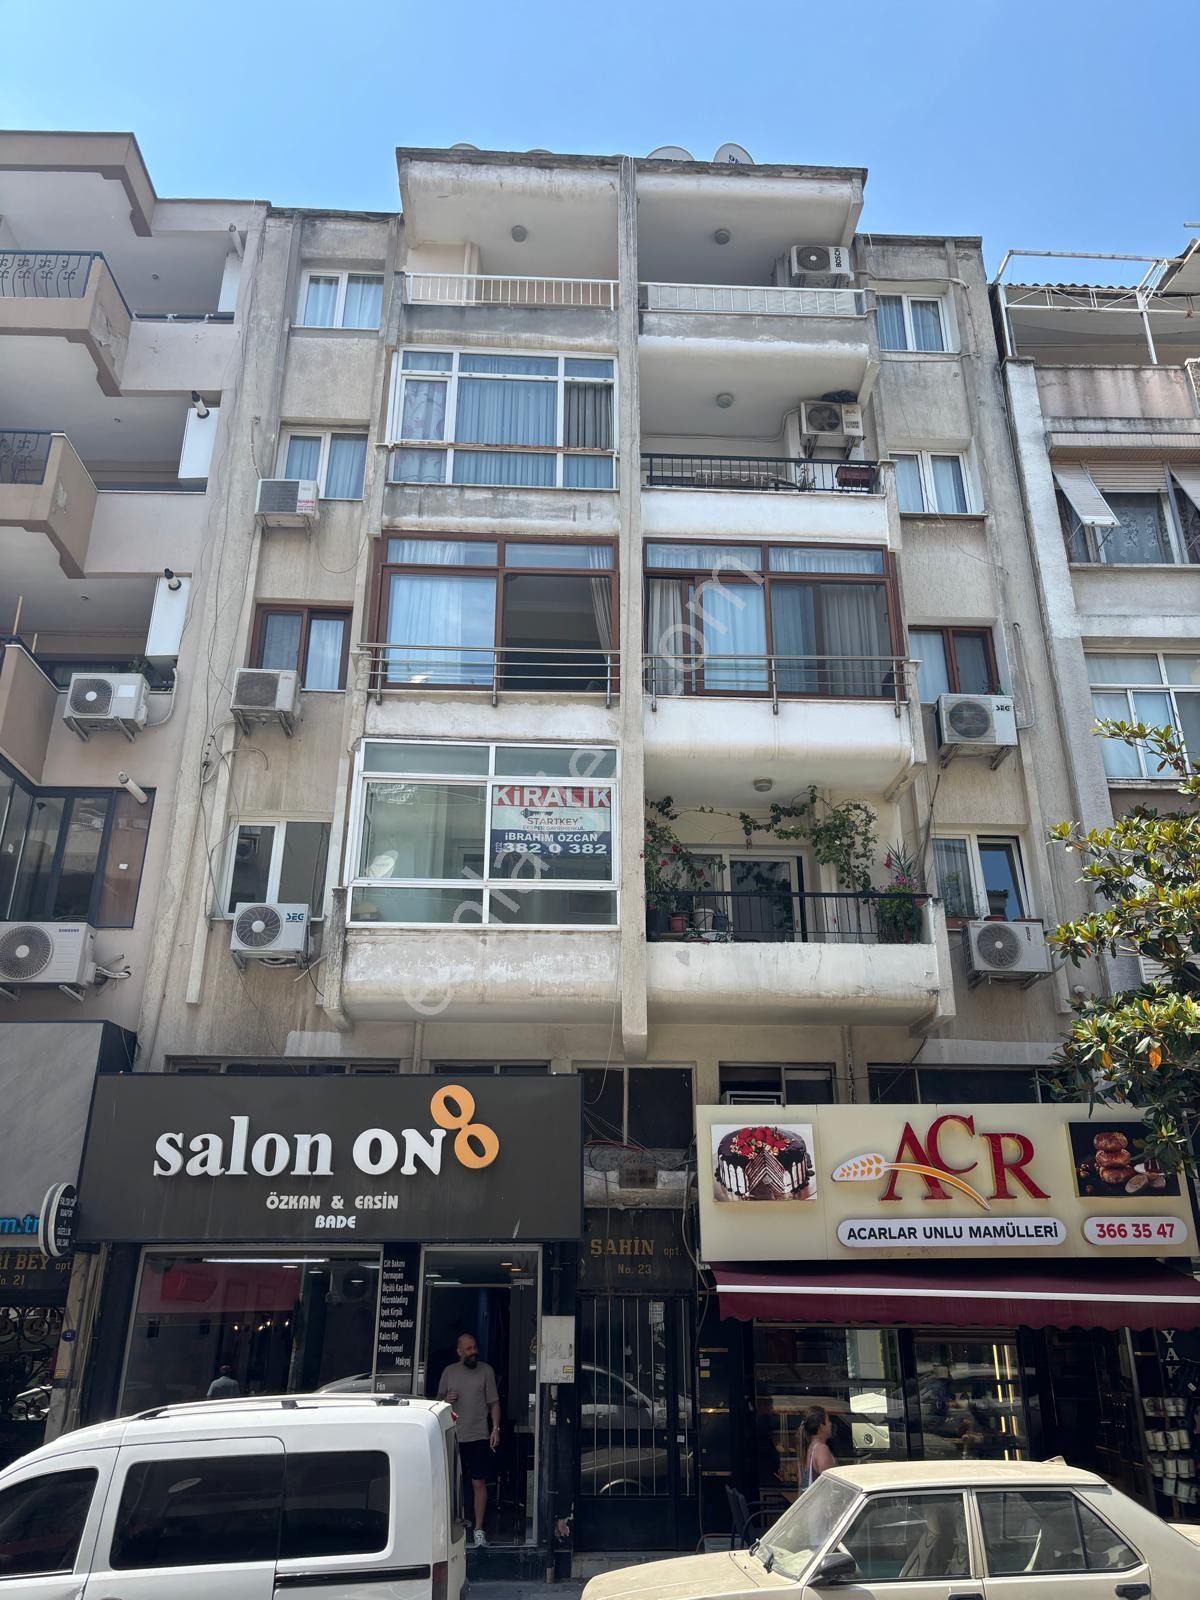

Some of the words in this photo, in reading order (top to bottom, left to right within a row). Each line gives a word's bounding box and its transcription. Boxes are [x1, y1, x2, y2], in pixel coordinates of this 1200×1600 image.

[834, 248, 842, 267] BOSCH
[527, 817, 579, 826] STARTKEY
[557, 832, 598, 842] ÖZCAN
[503, 842, 541, 853] 382
[549, 843, 562, 853] 0
[569, 843, 608, 854] 382
[286, 912, 304, 921] SEG
[153, 1115, 334, 1177] salon
[880, 1114, 1051, 1201] ACR
[266, 1191, 321, 1210] ÖZKAN
[331, 1195, 344, 1210] &
[354, 1190, 399, 1210] ERSİN
[314, 1215, 356, 1229] BADE
[847, 1227, 918, 1240] ACARLAR
[923, 1226, 964, 1240] UNLU
[969, 1220, 1059, 1239] MAMÜLLERİ
[1096, 1223, 1127, 1239] 366
[1131, 1223, 1152, 1239] 35
[1156, 1222, 1176, 1239] 47
